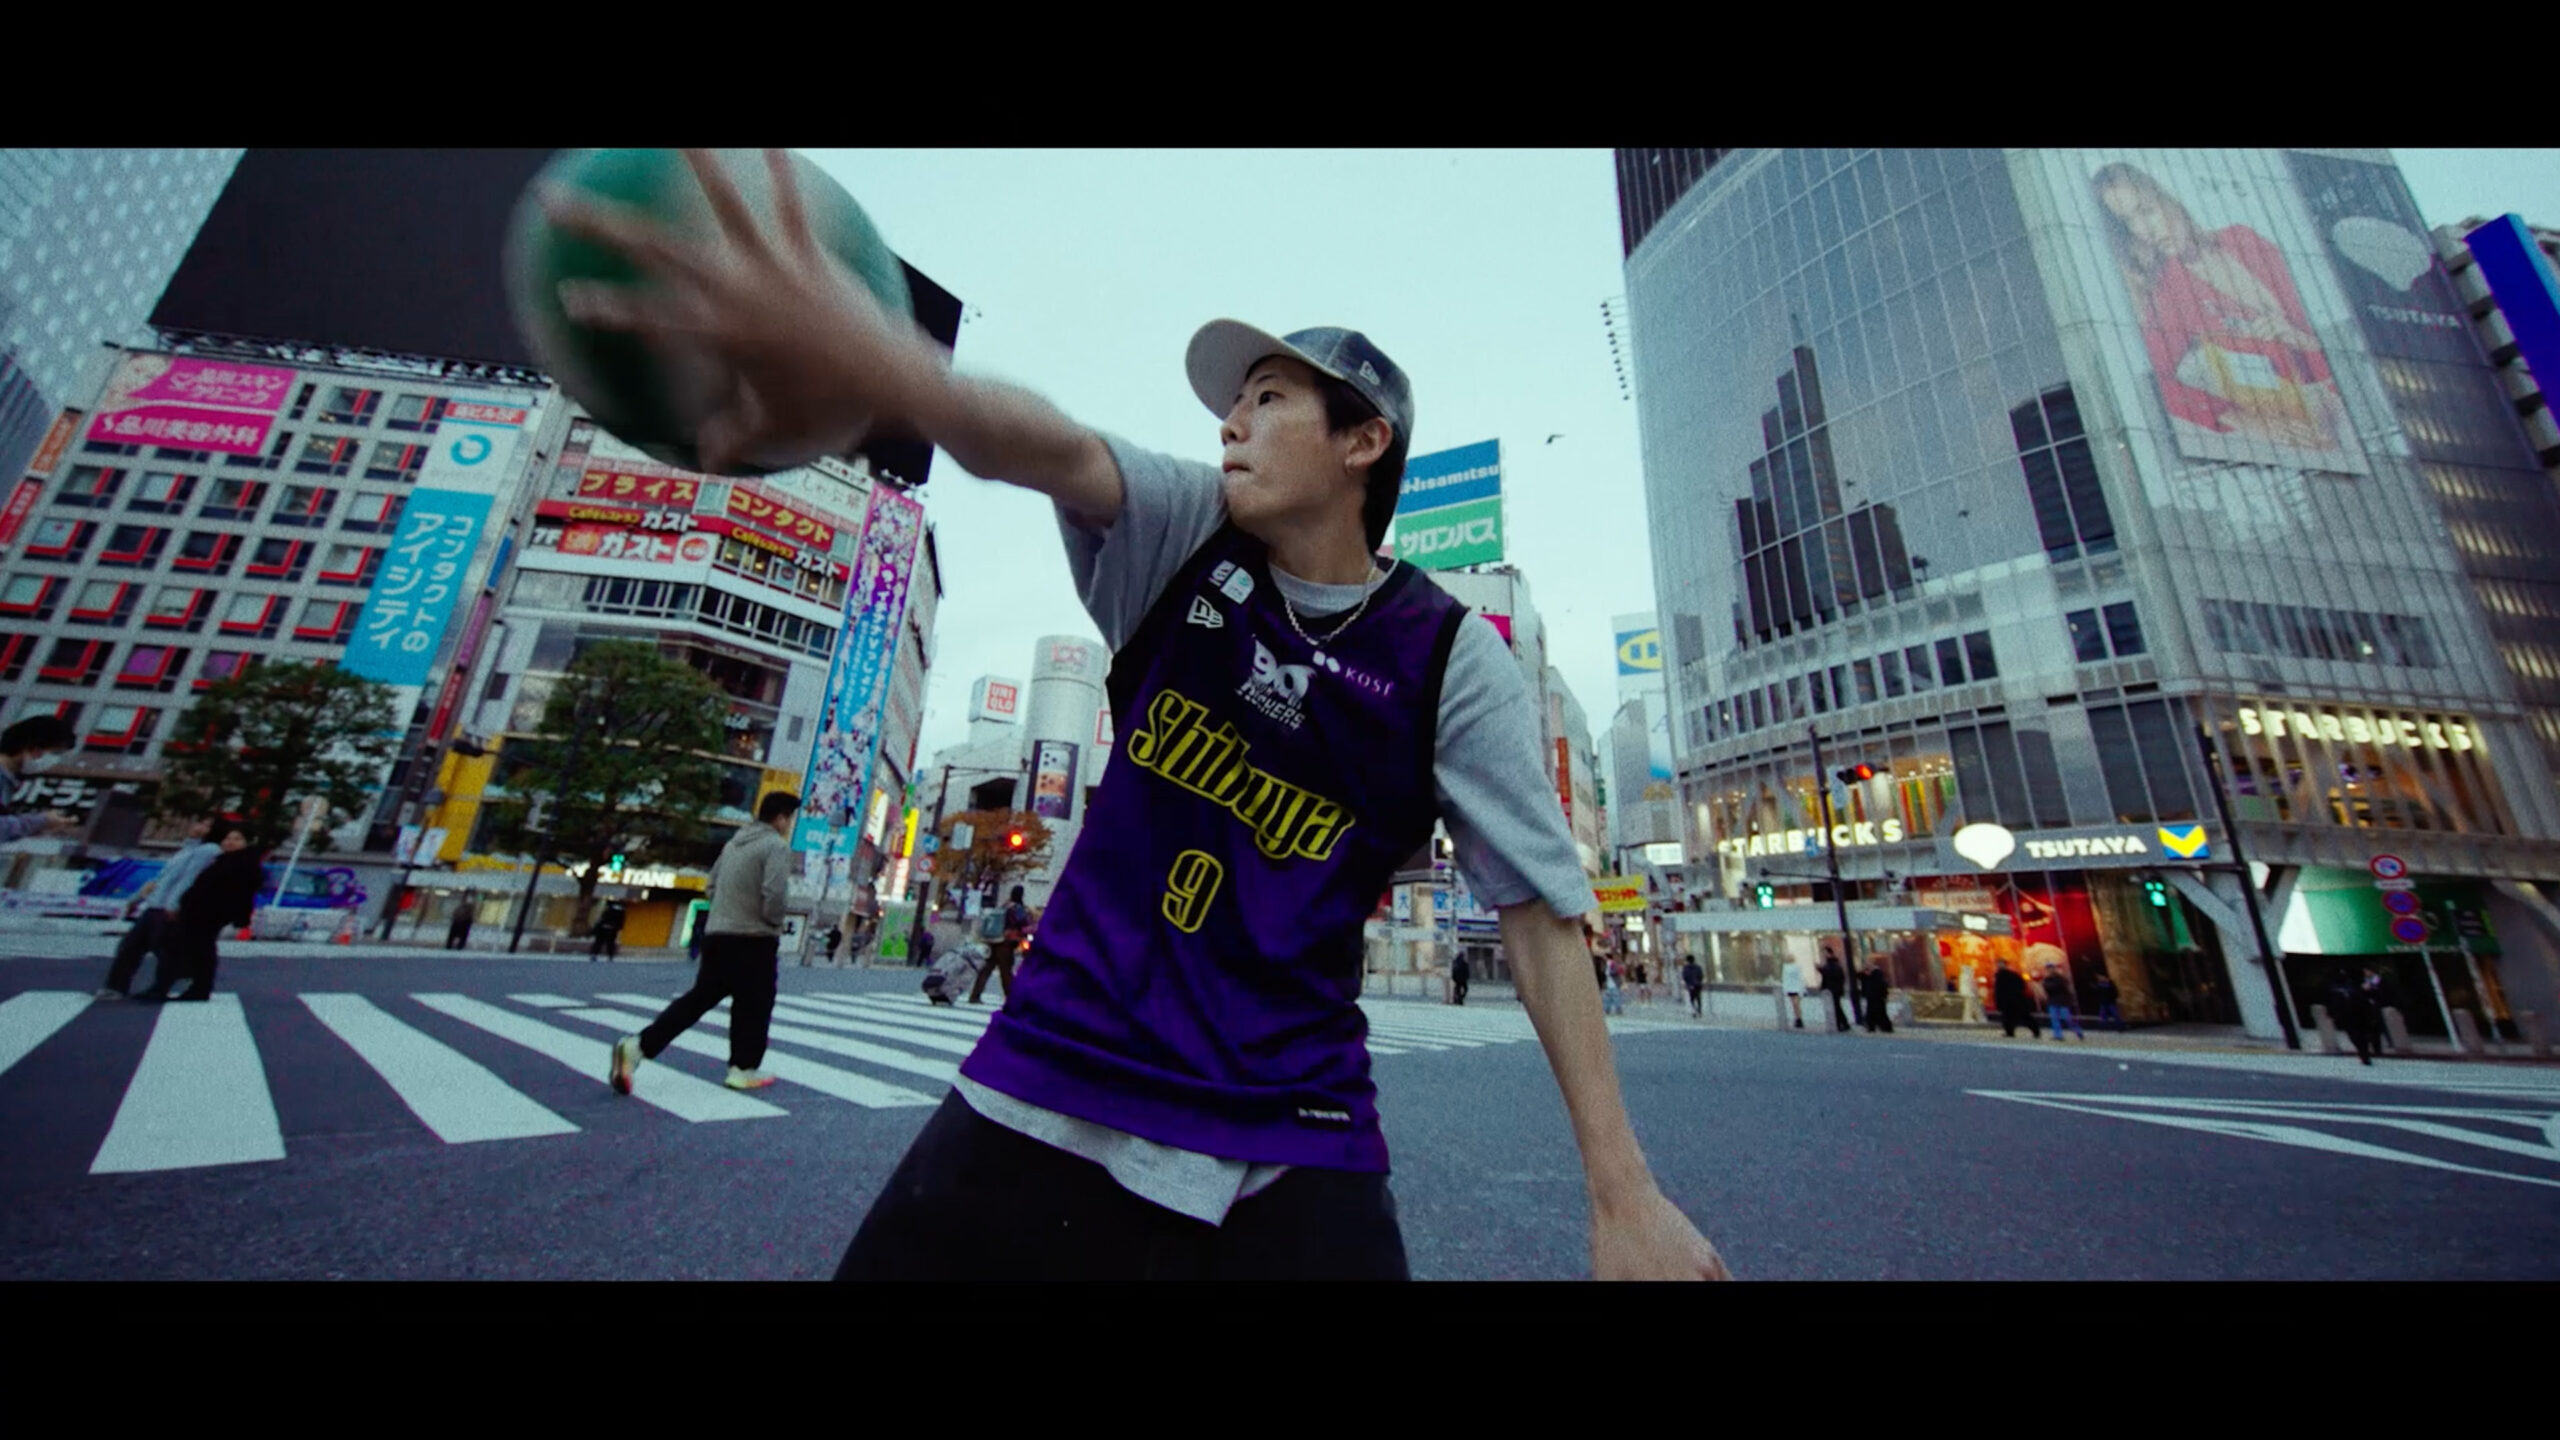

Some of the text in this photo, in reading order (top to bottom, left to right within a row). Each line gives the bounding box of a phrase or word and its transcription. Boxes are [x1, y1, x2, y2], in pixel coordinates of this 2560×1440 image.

[114, 414, 261, 447] 品川美容外科
[640, 510, 699, 532] ガスト
[729, 489, 832, 543] コンタクト
[533, 527, 563, 545] 7F
[597, 531, 673, 561] ガスト
[794, 549, 842, 576] ガスト
[368, 511, 446, 650] アイシティ
[401, 515, 475, 652] コンタクトの
[988, 697, 1013, 711] QLO
[991, 685, 1014, 700] UNI
[2237, 707, 2474, 751] STARBUCKS
[1127, 688, 1356, 862] Shibuya
[2023, 834, 2149, 859] TSUTAYA
[1161, 848, 1225, 934] 9
